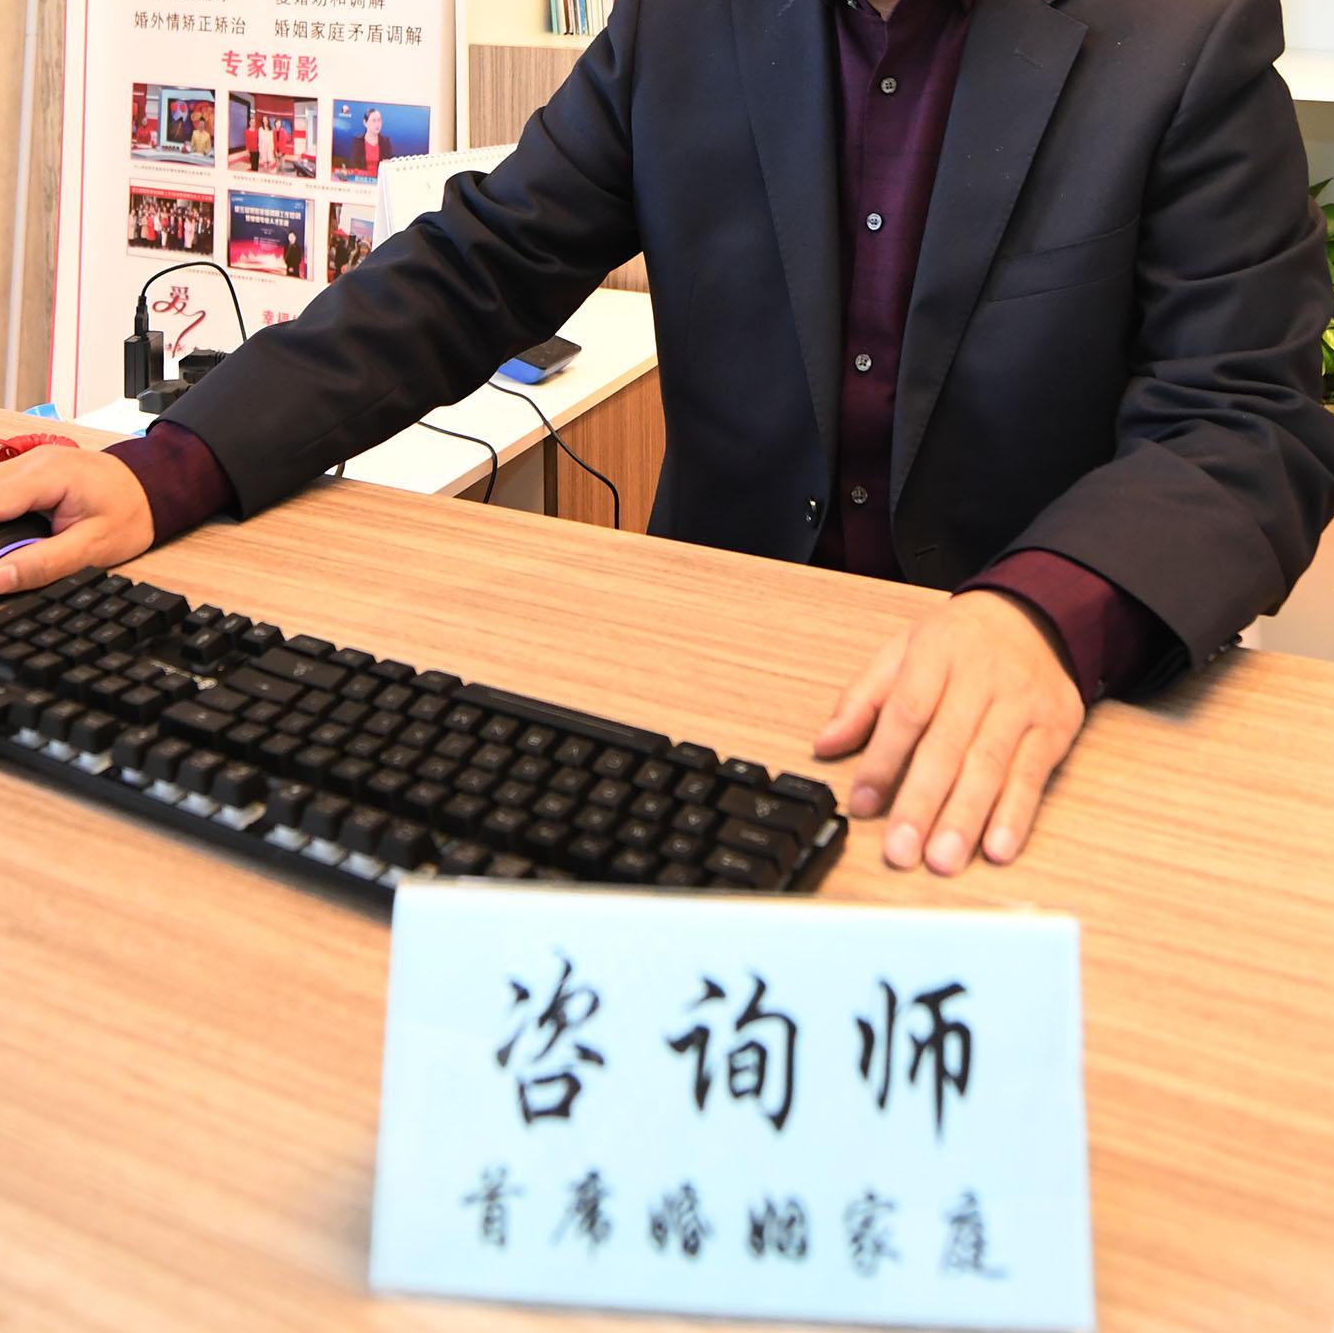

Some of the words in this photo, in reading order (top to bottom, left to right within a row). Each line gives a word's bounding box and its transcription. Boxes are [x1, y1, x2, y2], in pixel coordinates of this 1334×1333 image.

[134, 11, 246, 36] 婚外情矫正矫治
[274, 19, 423, 46] 婚姻家庭矛盾调解
[221, 50, 318, 83] 专家剪影
[495, 949, 975, 1145] 咨询师
[463, 1165, 1008, 1281] 首席婚姻家庭
